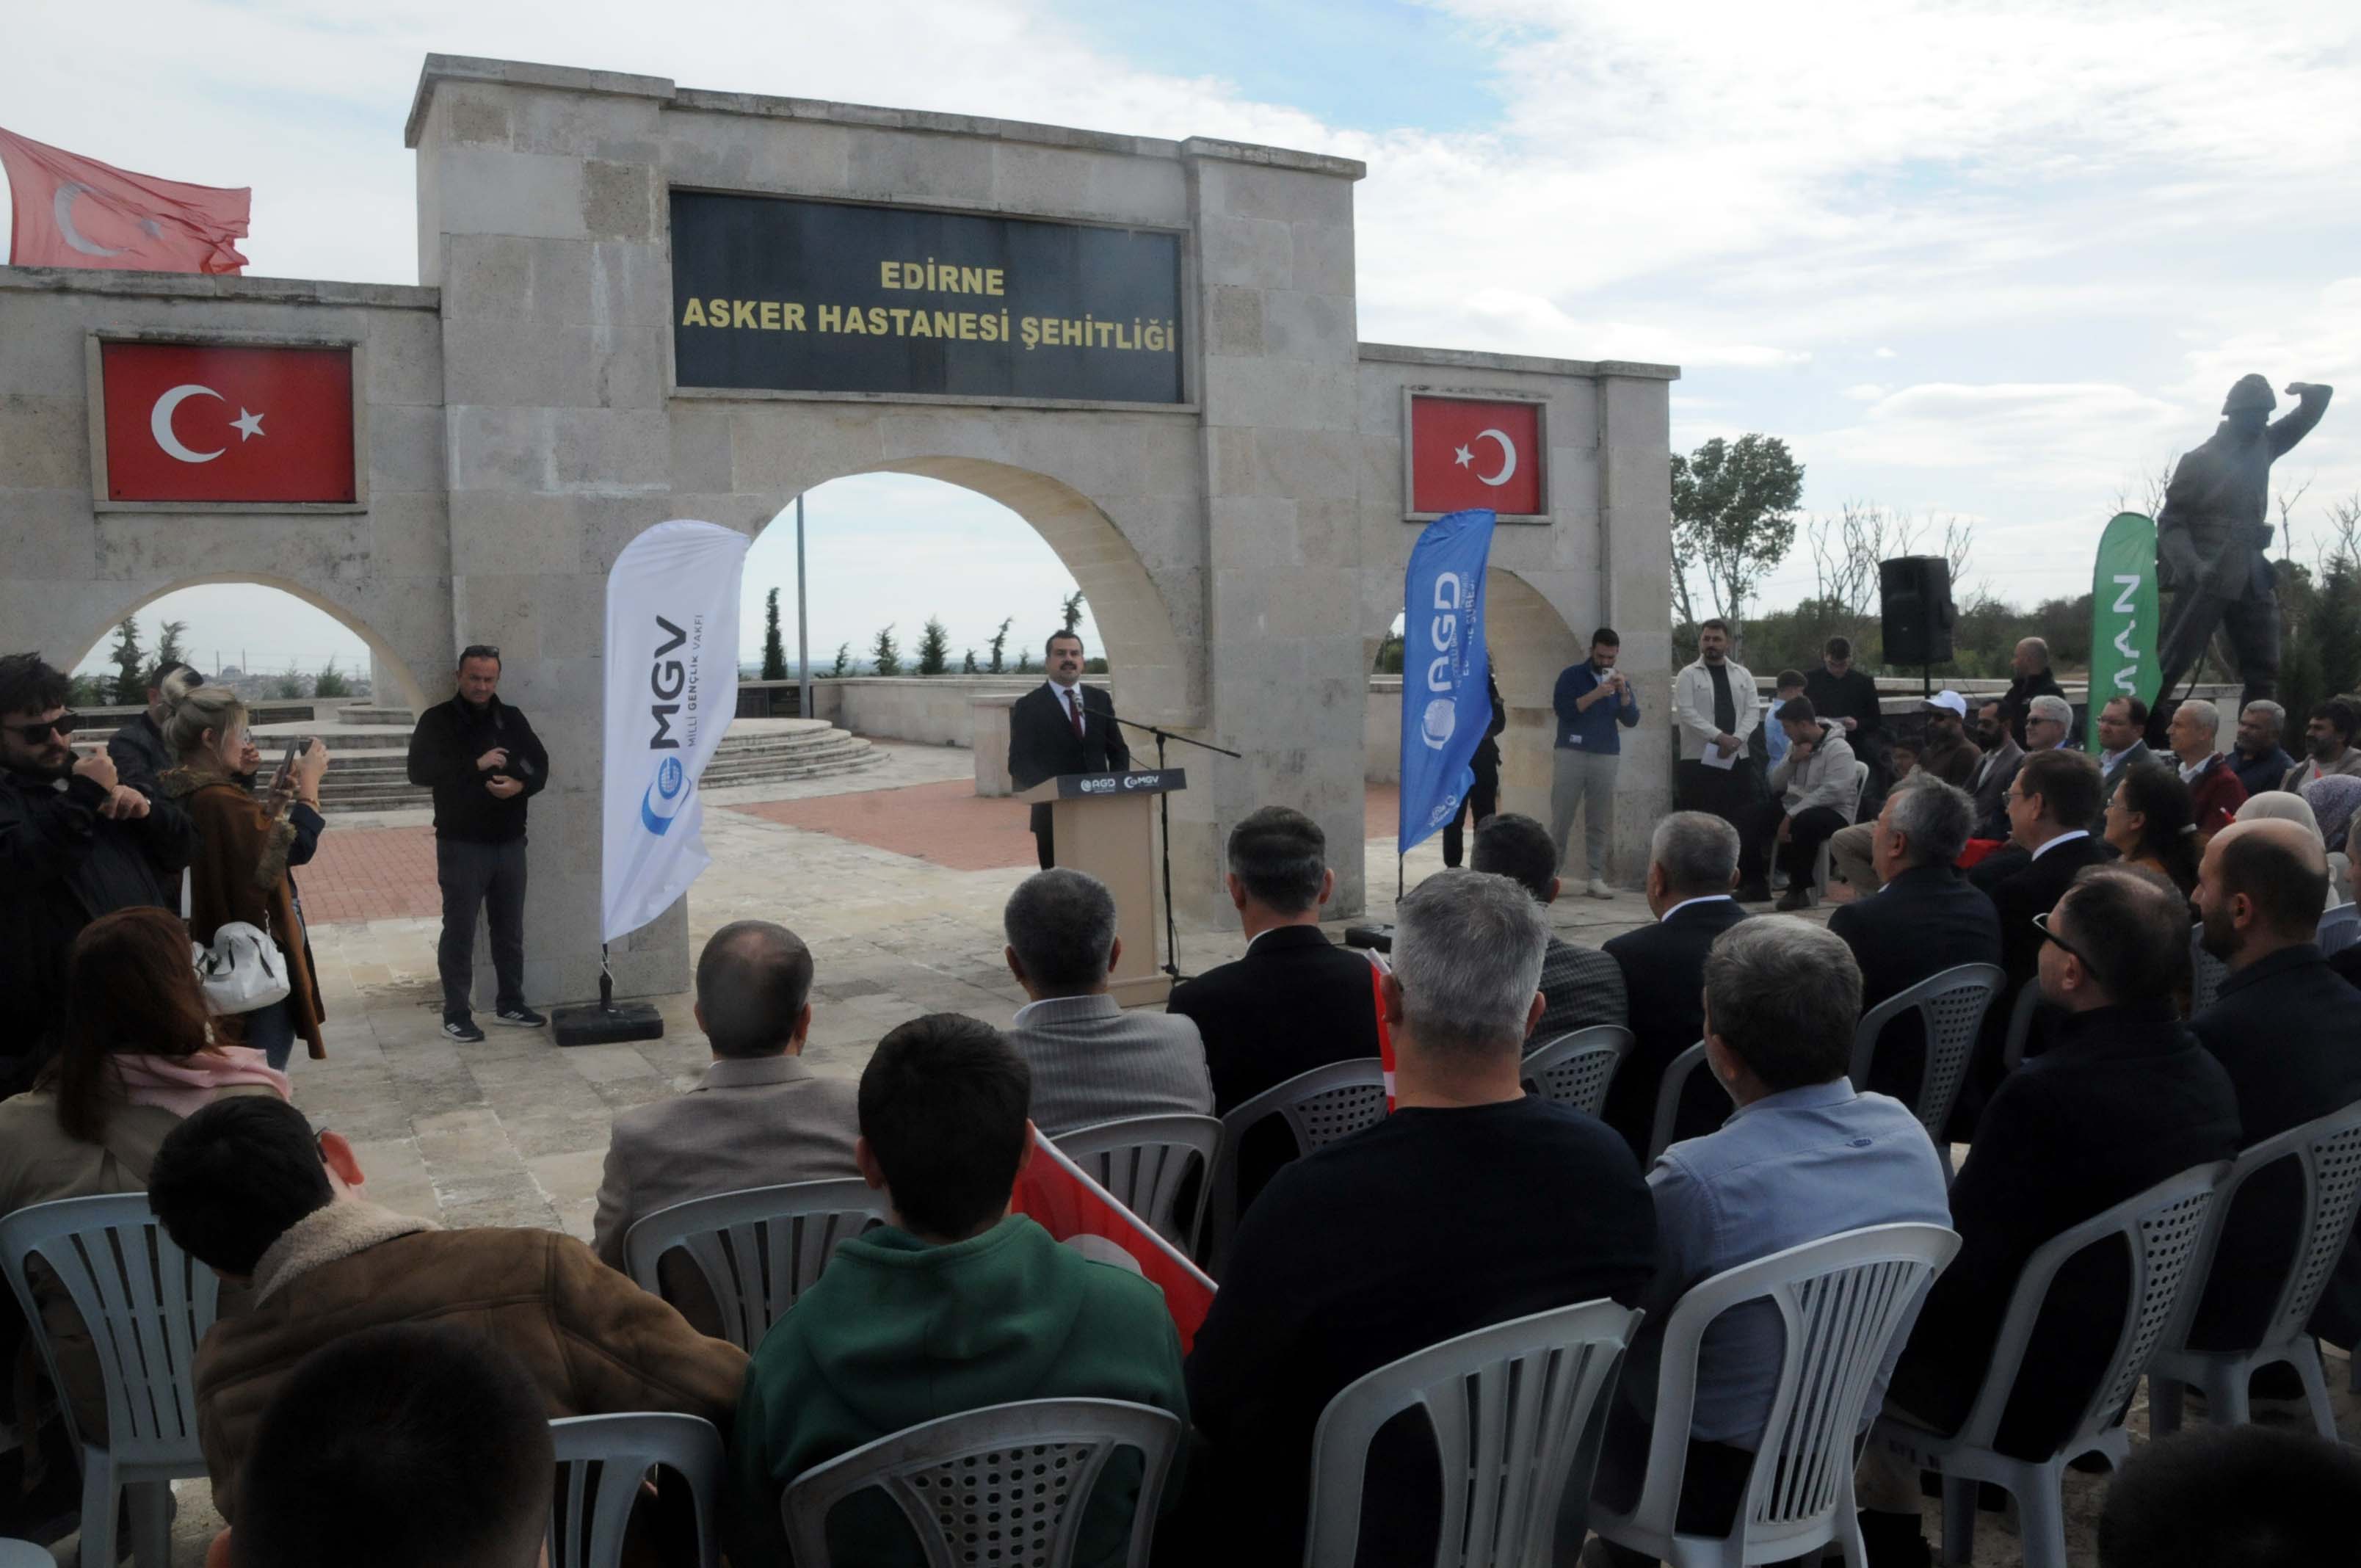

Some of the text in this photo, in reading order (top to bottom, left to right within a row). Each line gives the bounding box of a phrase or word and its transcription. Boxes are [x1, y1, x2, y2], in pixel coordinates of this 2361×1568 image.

[881, 256, 1004, 296] EDİRNE
[682, 297, 1175, 352] ASKER HASTANESİ ŞEHİTLİĞİ
[692, 614, 704, 650] VAKFI
[1428, 571, 1462, 692] AGD
[650, 614, 687, 749] MGV
[688, 656, 699, 711] GENÇLİK
[1092, 778, 1116, 788] AGD
[1137, 775, 1159, 784] MGV
